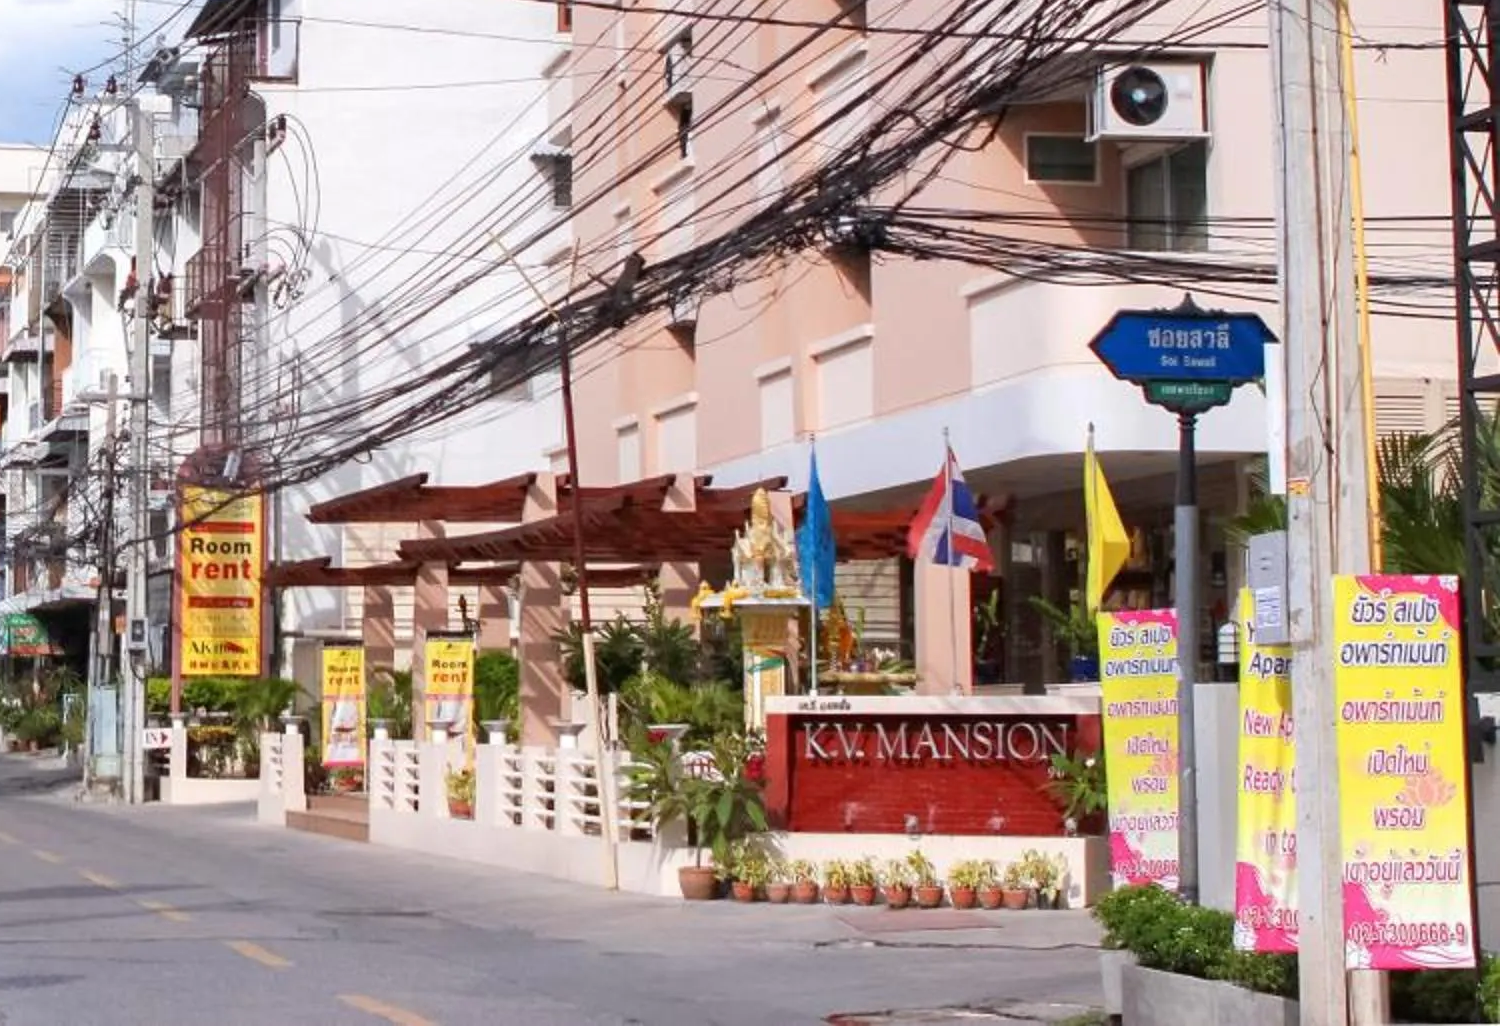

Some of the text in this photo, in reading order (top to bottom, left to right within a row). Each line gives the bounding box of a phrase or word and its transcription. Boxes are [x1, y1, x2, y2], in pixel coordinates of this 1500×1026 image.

[190, 537, 252, 554] Room
[190, 560, 252, 580] rent
[431, 659, 468, 669] Room
[432, 671, 468, 684] rent
[1244, 709, 1272, 735] New
[876, 722, 1069, 761] MANSION
[1244, 765, 1285, 799] Ready
